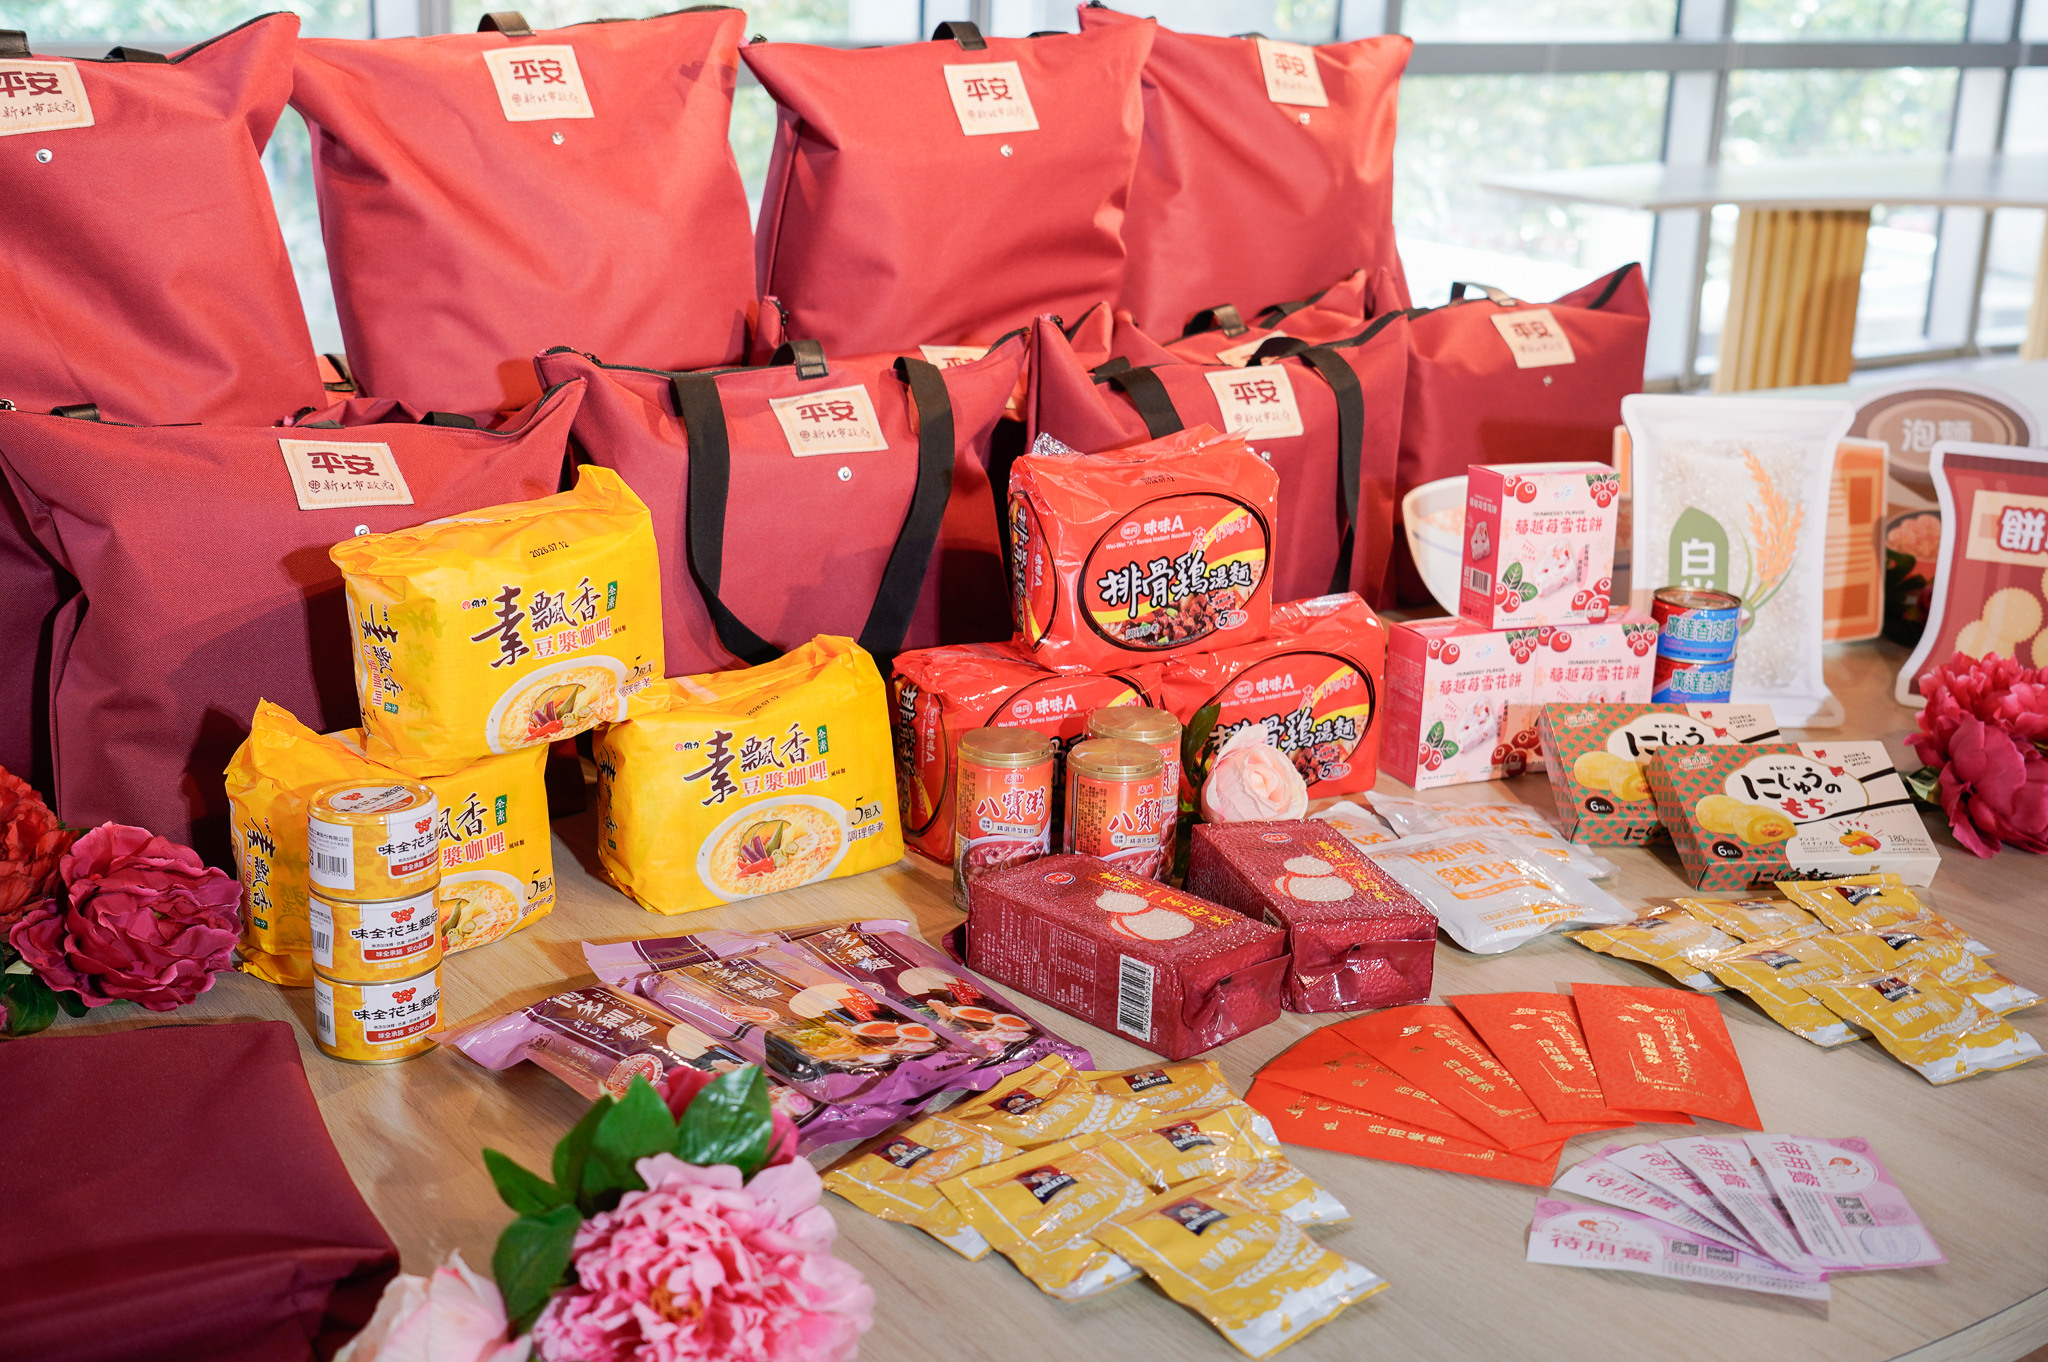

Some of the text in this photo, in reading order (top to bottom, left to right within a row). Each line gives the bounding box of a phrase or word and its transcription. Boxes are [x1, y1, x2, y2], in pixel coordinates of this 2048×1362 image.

[510, 59, 567, 85] 平安
[1273, 52, 1309, 78] 平安
[0, 71, 63, 98] 平安
[964, 78, 1012, 101] 平安
[3, 100, 76, 119] 新北市政府
[1229, 380, 1280, 405] 平安
[796, 400, 858, 423] 平安
[812, 427, 871, 440] 新北市政府
[307, 452, 380, 476] 平安
[323, 480, 395, 492] 新北市政府
[1136, 536, 1152, 545] Series
[1171, 530, 1191, 539] Noodles
[1144, 515, 1185, 535] 味味A
[2000, 508, 2048, 552] 餅
[530, 540, 570, 558] 2026.07.12
[608, 583, 618, 611] 全素
[471, 577, 602, 669] 素飄香
[533, 616, 613, 660] 豆漿咖哩
[1255, 673, 1296, 695] 味味A
[1035, 693, 1078, 714] 味味A
[1029, 716, 1045, 725] Series
[817, 729, 829, 753] 全素
[683, 722, 811, 806] 素飄香
[1843, 751, 1866, 759] DOUBLE
[742, 760, 828, 797] 豆漿咖哩
[1740, 766, 1843, 801] にじゅうの
[495, 797, 507, 824] 全素
[852, 796, 881, 826] 5包入
[976, 787, 1046, 822] 八寶粥
[1780, 796, 1826, 819] もち
[847, 822, 885, 843] 調理參考
[1717, 843, 1741, 856] 6個入
[527, 867, 554, 901] 5包入
[1779, 965, 1838, 991] 鮮奶麥片
[551, 991, 658, 1042] 博多細麵
[1892, 998, 1957, 1026] 鮮奶麥片
[616, 1059, 645, 1089] HAKATA
[1130, 1074, 1169, 1090] QUAKER
[1442, 1057, 1496, 1094] 待用餐券
[1008, 1097, 1045, 1115] QUAKER
[1146, 1083, 1203, 1107] 奶麥片
[1394, 1084, 1441, 1105] 待用
[1019, 1093, 1089, 1139] 鮮奶麥片
[1367, 1122, 1447, 1146] 待用餐券
[893, 1145, 930, 1169] QUAKER
[909, 1145, 978, 1187] 鮮奶麥片
[1690, 1143, 1753, 1189] 待用餐
[1771, 1141, 1822, 1188] 待用餐
[1032, 1172, 1073, 1199] QUAKER
[1584, 1171, 1678, 1212] 待用餐
[1185, 1209, 1223, 1232] QUAKER
[1199, 1219, 1274, 1271] 鮮奶麥片
[1549, 1232, 1653, 1264] 待用餐
